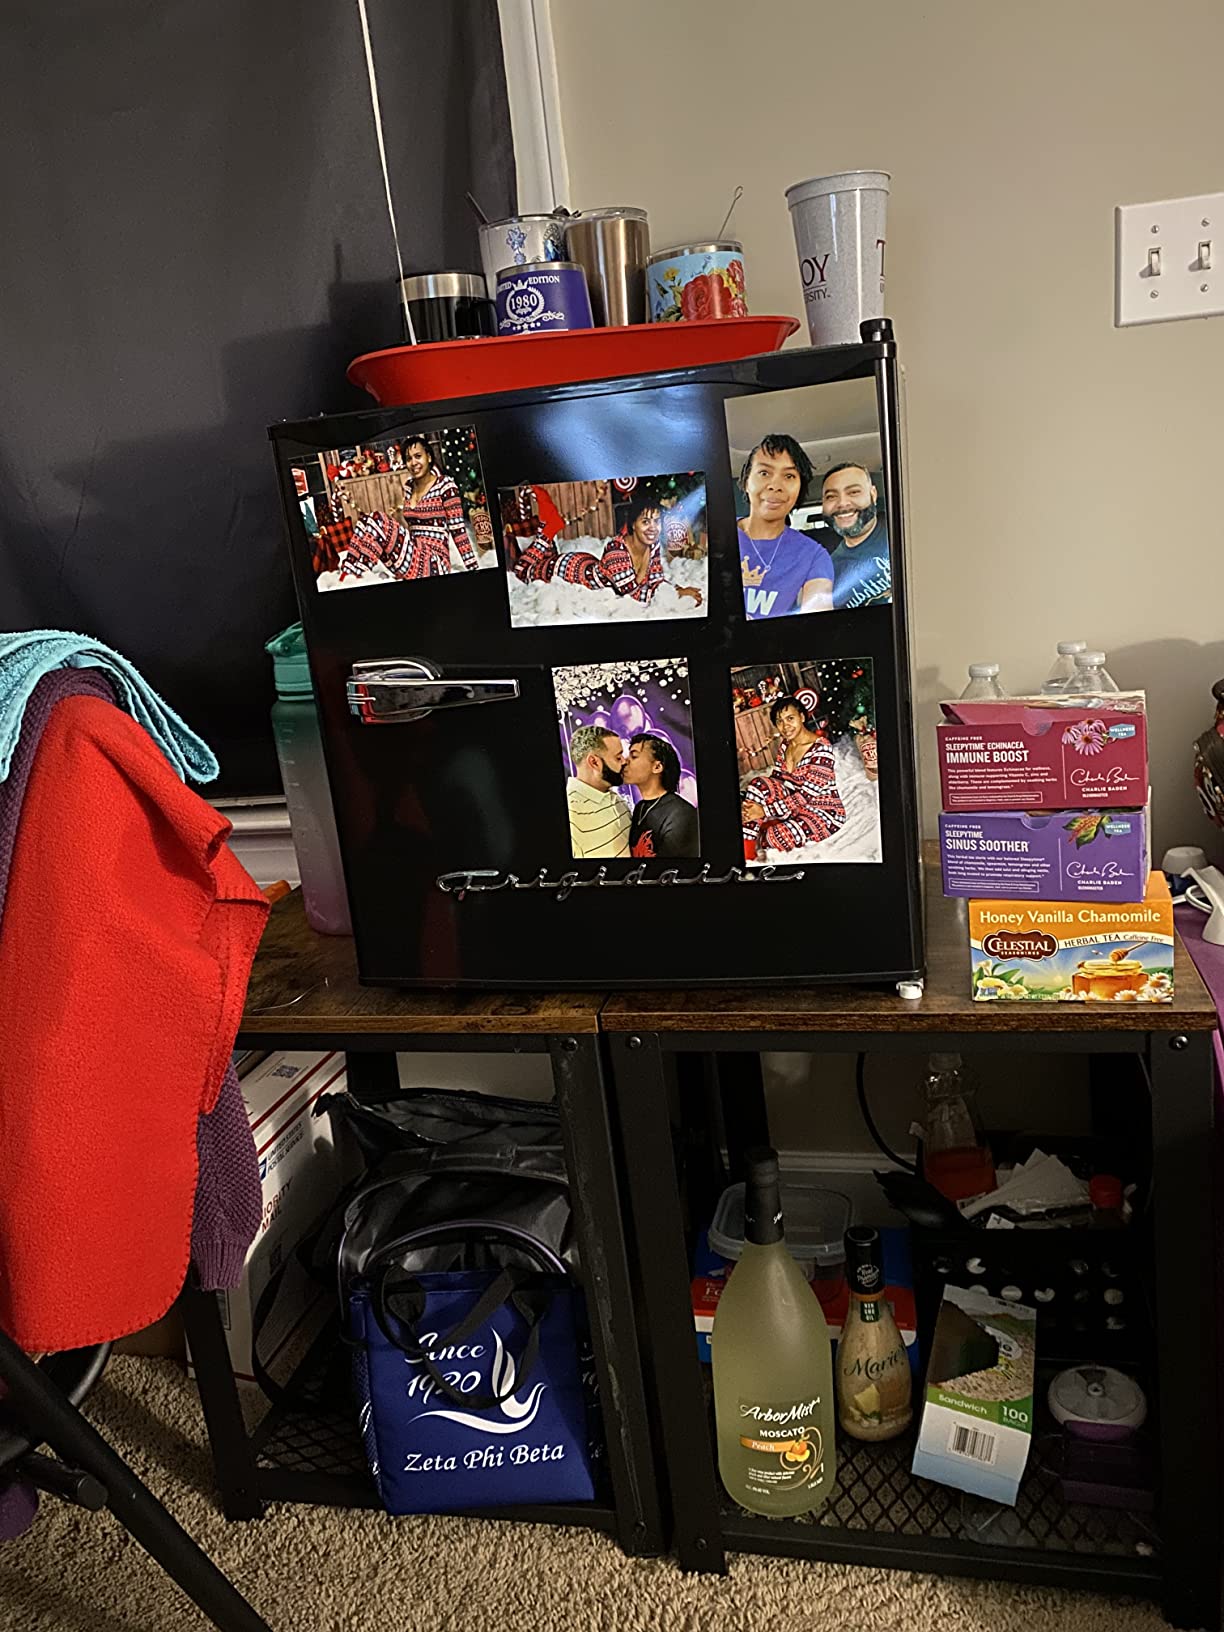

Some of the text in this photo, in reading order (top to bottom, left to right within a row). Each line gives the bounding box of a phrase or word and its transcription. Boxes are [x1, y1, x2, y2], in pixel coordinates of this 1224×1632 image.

[801, 253, 831, 287] OY
[528, 275, 560, 285] EDITION
[511, 294, 538, 310] 1980
[945, 742, 1025, 751] SLEEPYTIME ECHINACEA
[946, 750, 1029, 763] IMMUNE BOOST
[945, 830, 983, 838] SLEEPYTIME
[946, 839, 1029, 852] SINUS SOOTHER
[436, 863, 805, 900] Frigidaire
[980, 909, 1161, 925] Honey Vanilla Chamomile
[988, 937, 1052, 951] CELESTIAL
[1064, 937, 1099, 948] HERBAL
[1123, 934, 1150, 942] Caffeine
[263, 1176, 294, 1216] IORITY
[939, 1394, 988, 1415] Sandwich
[1003, 1406, 1028, 1423] 100
[760, 1426, 805, 1438] MOSCATO
[751, 1441, 775, 1451] Peach
[404, 1453, 457, 1472] Zeta
[463, 1446, 504, 1470] Phi
[510, 1444, 565, 1465] Beta
